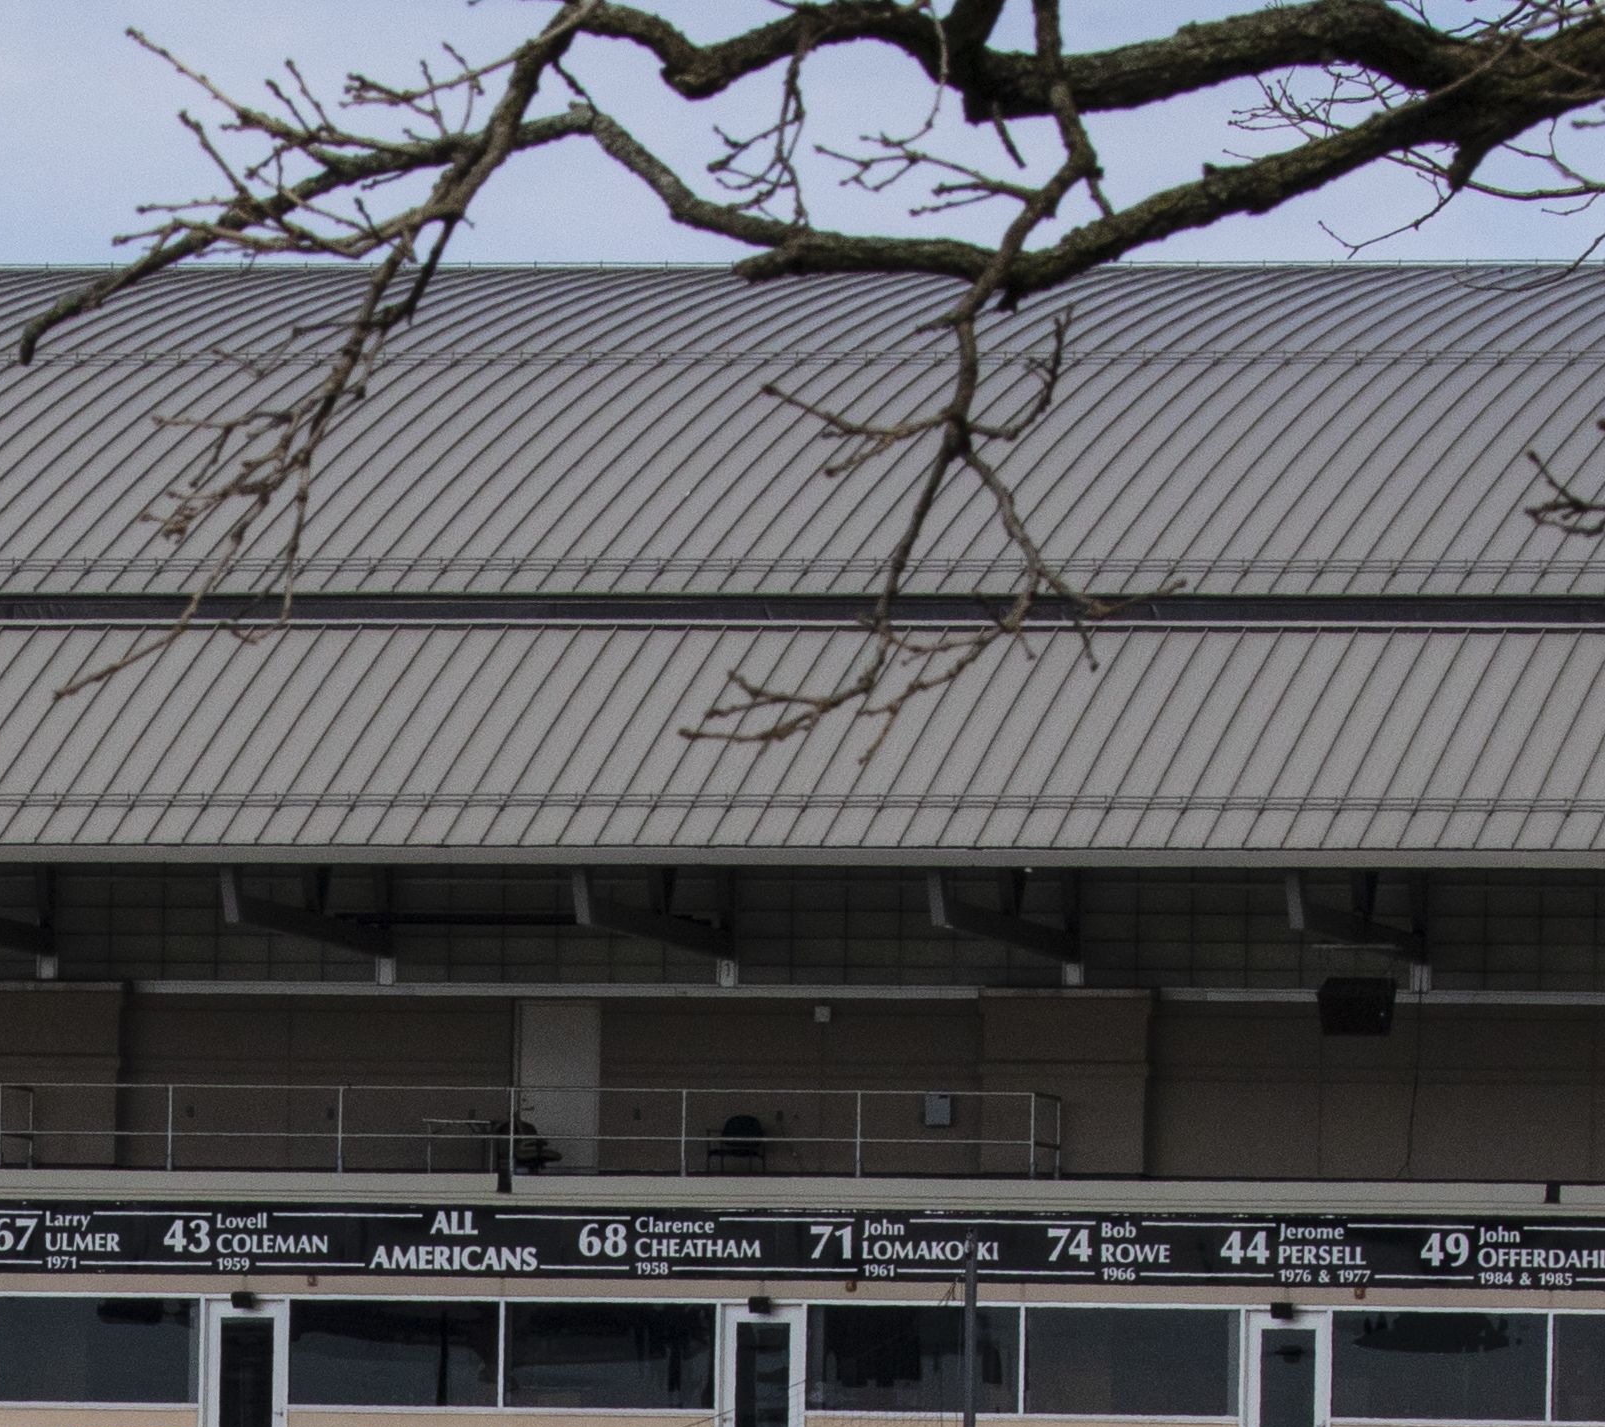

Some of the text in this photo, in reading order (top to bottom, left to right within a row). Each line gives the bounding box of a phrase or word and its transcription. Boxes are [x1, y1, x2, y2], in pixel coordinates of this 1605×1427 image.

[45, 1211, 91, 1231] Larry
[217, 1212, 267, 1228] Lovell
[430, 1211, 478, 1234] ALL
[635, 1219, 715, 1235] Clarence
[863, 1219, 904, 1238] John
[164, 1220, 210, 1252] 43
[1101, 1222, 1136, 1238] Bob
[1279, 1224, 1344, 1242] Jerome
[1479, 1226, 1520, 1245] John
[45, 1233, 119, 1252] ULMER
[217, 1234, 327, 1253] COLEMAN
[579, 1224, 627, 1256] 68
[635, 1240, 761, 1258] CHEATHAM
[811, 1226, 851, 1258] 71
[1048, 1228, 1092, 1262] 74
[1221, 1231, 1269, 1264] 44
[1421, 1233, 1469, 1266] 49
[369, 1246, 537, 1270] AMERICANS
[863, 1240, 999, 1260] LOMAKOKI
[1101, 1244, 1169, 1262] ROWE
[1279, 1246, 1366, 1264] PERSELL
